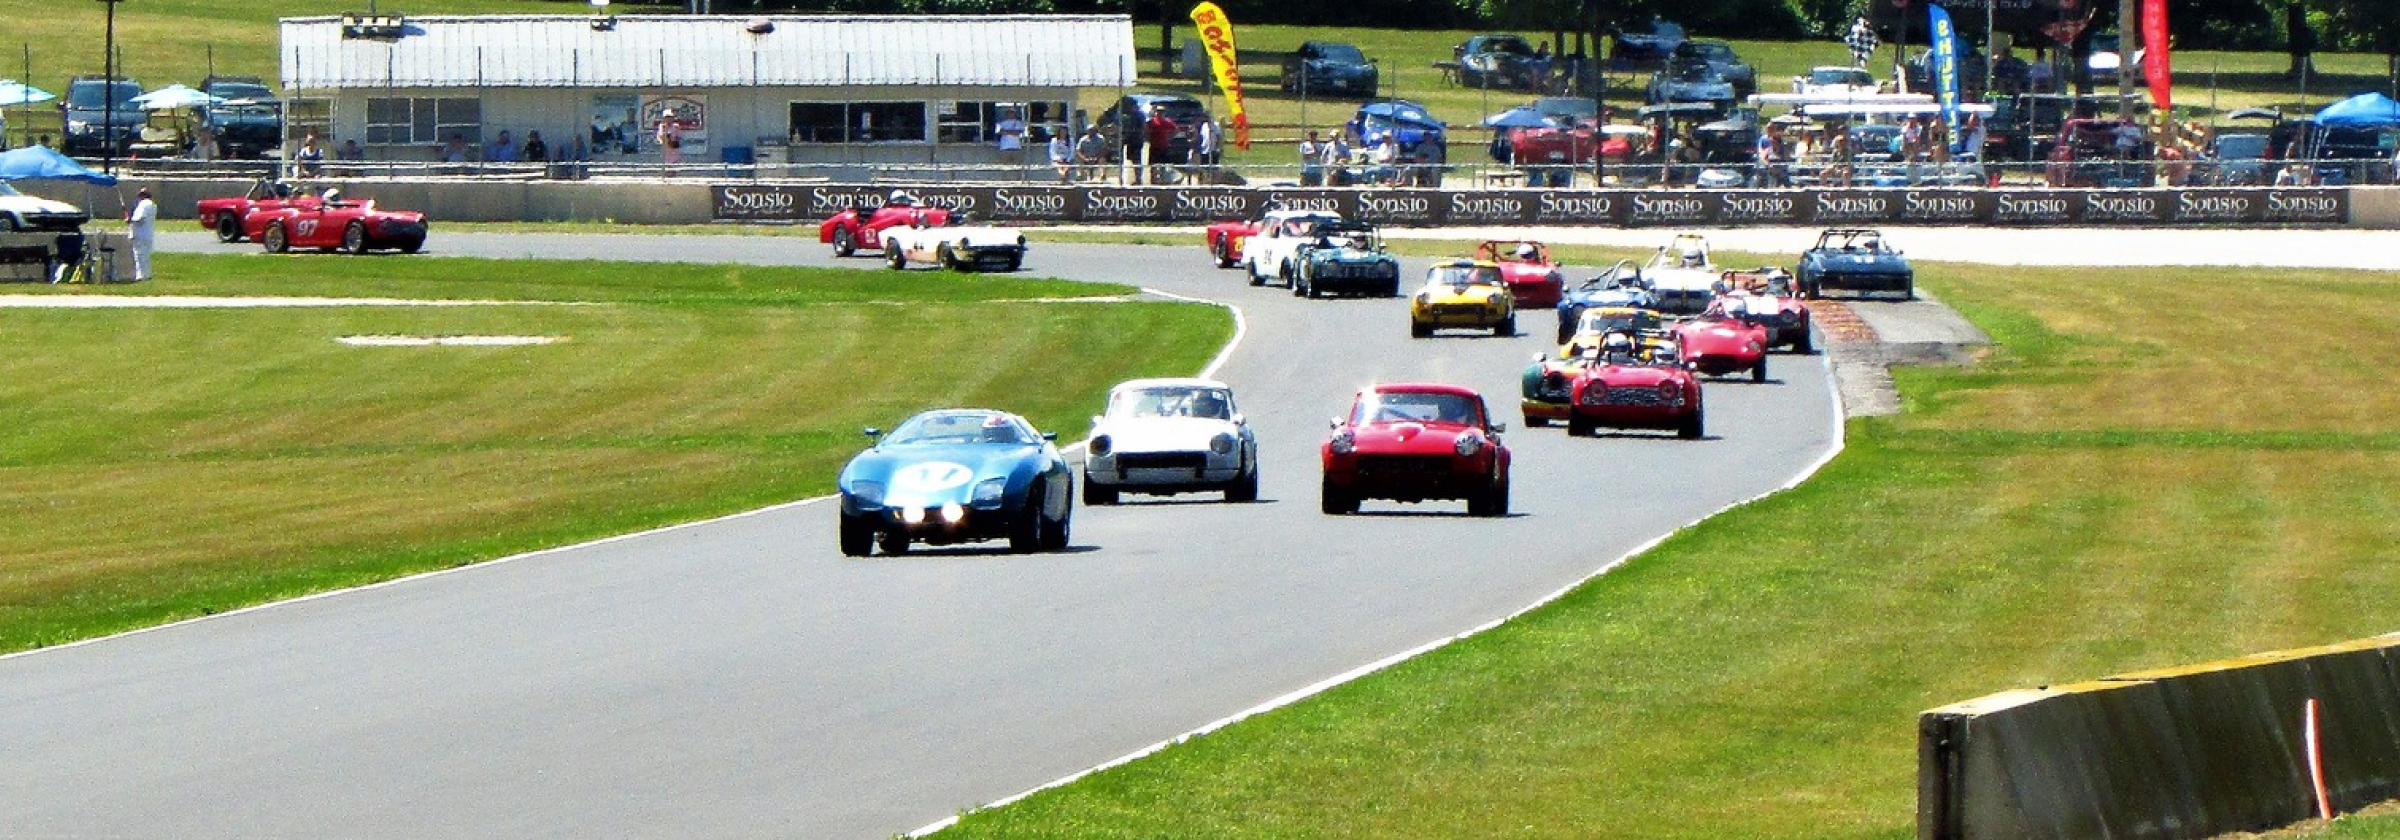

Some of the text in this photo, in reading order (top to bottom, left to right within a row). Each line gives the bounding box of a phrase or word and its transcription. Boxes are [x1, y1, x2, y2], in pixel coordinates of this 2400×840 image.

[723, 187, 793, 208] Sonsio
[994, 188, 1065, 210] Sonsio
[1087, 189, 1157, 210] Sonsio
[1176, 189, 1246, 210] Sonsio
[1358, 191, 1428, 212] Sonsio
[1451, 192, 1522, 213] Sonsio
[1540, 190, 1611, 213] Sonsio
[1632, 192, 1703, 213] Sonsio
[1722, 191, 1793, 213] Sonsio
[1816, 191, 1887, 213] Sonsio
[1905, 191, 1976, 212] Sonsio
[1998, 191, 2068, 213] Sonsio
[2086, 190, 2155, 212] Sonsio
[2179, 191, 2249, 212] Sonsio
[2268, 191, 2338, 212] Sonsio
[297, 218, 319, 236] 97
